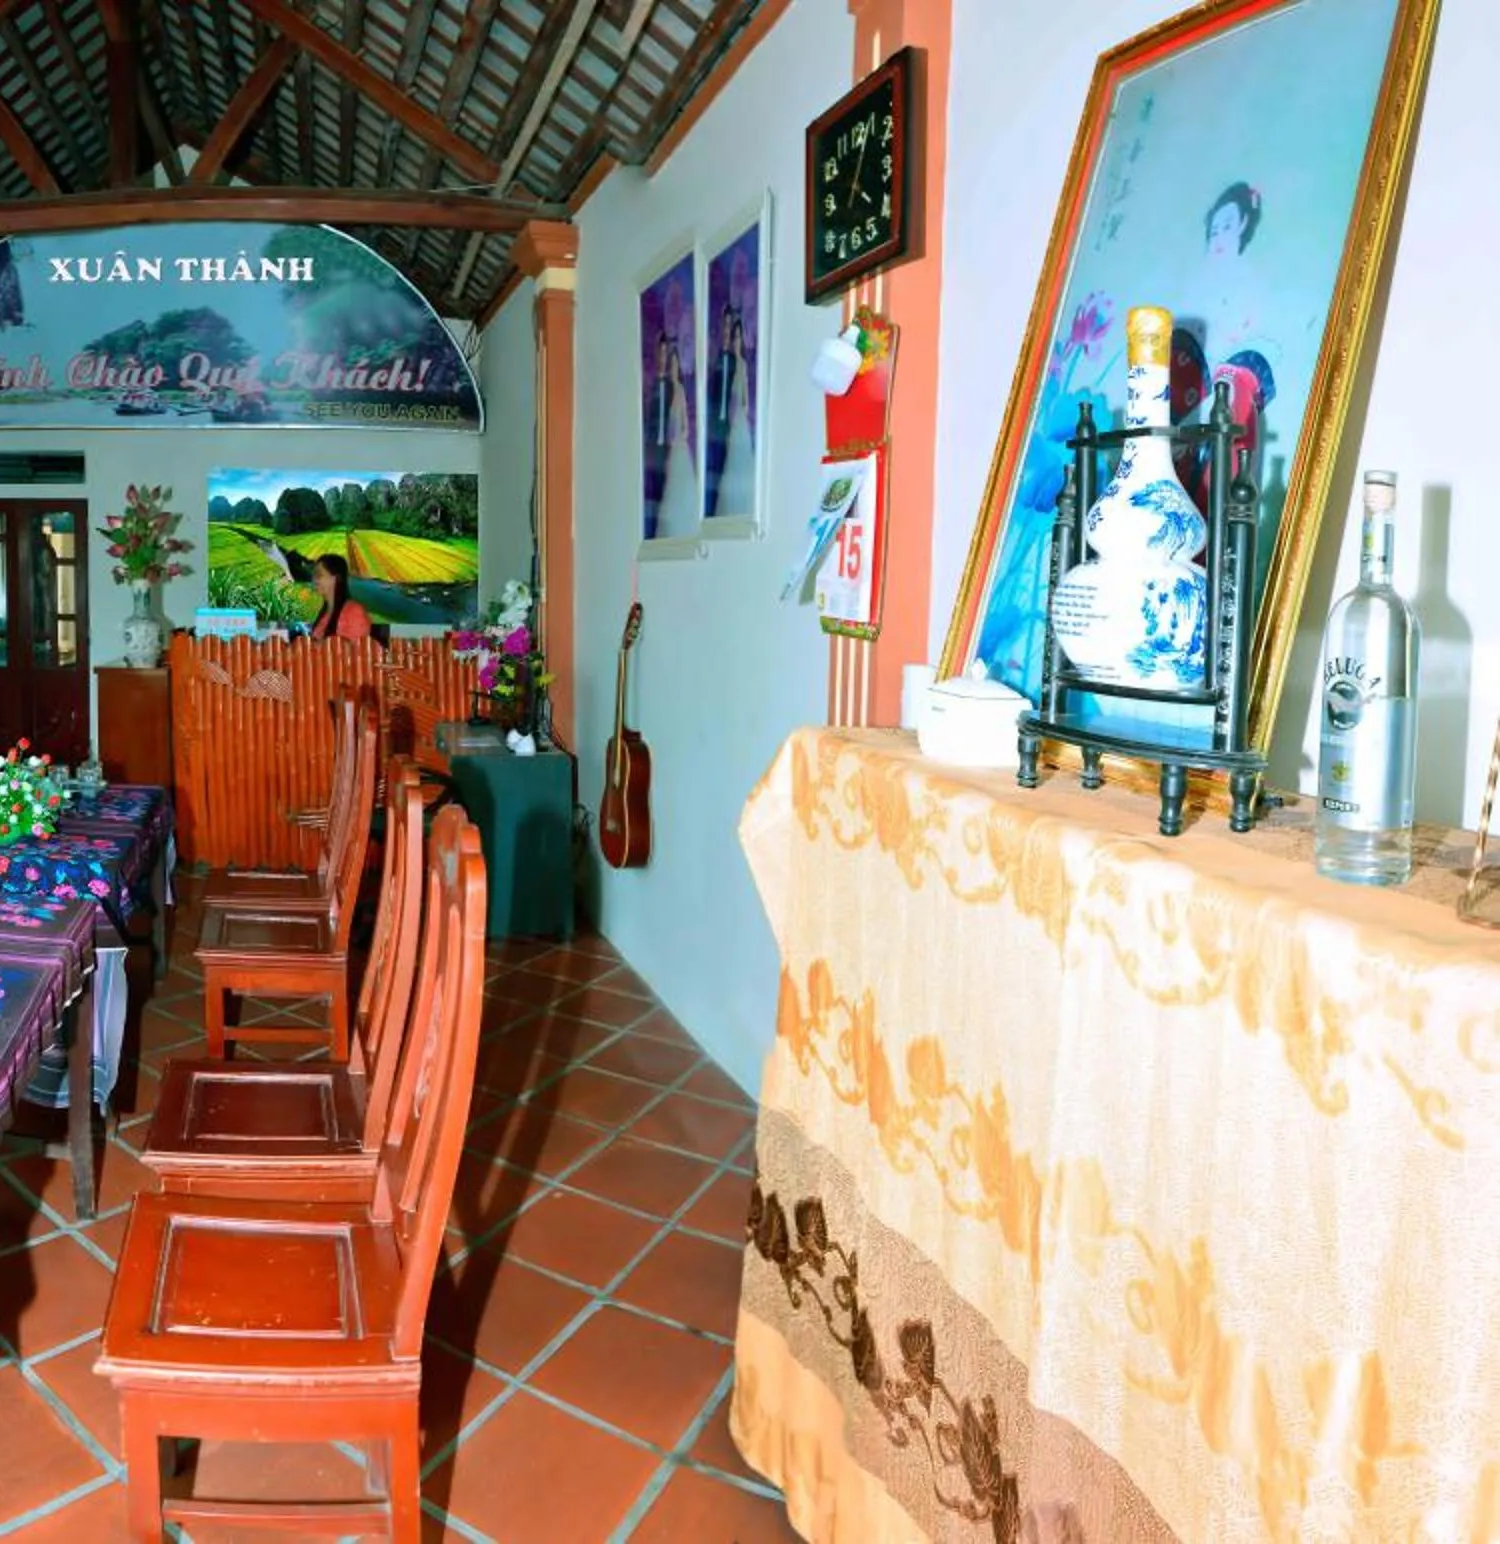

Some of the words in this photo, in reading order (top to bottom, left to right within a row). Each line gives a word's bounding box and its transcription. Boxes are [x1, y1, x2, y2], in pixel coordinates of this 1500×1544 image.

[49, 250, 164, 283] XUÂN
[270, 349, 432, 393] Khách!
[306, 401, 341, 420] SEE
[350, 402, 392, 420] YOU
[835, 523, 863, 580] 15
